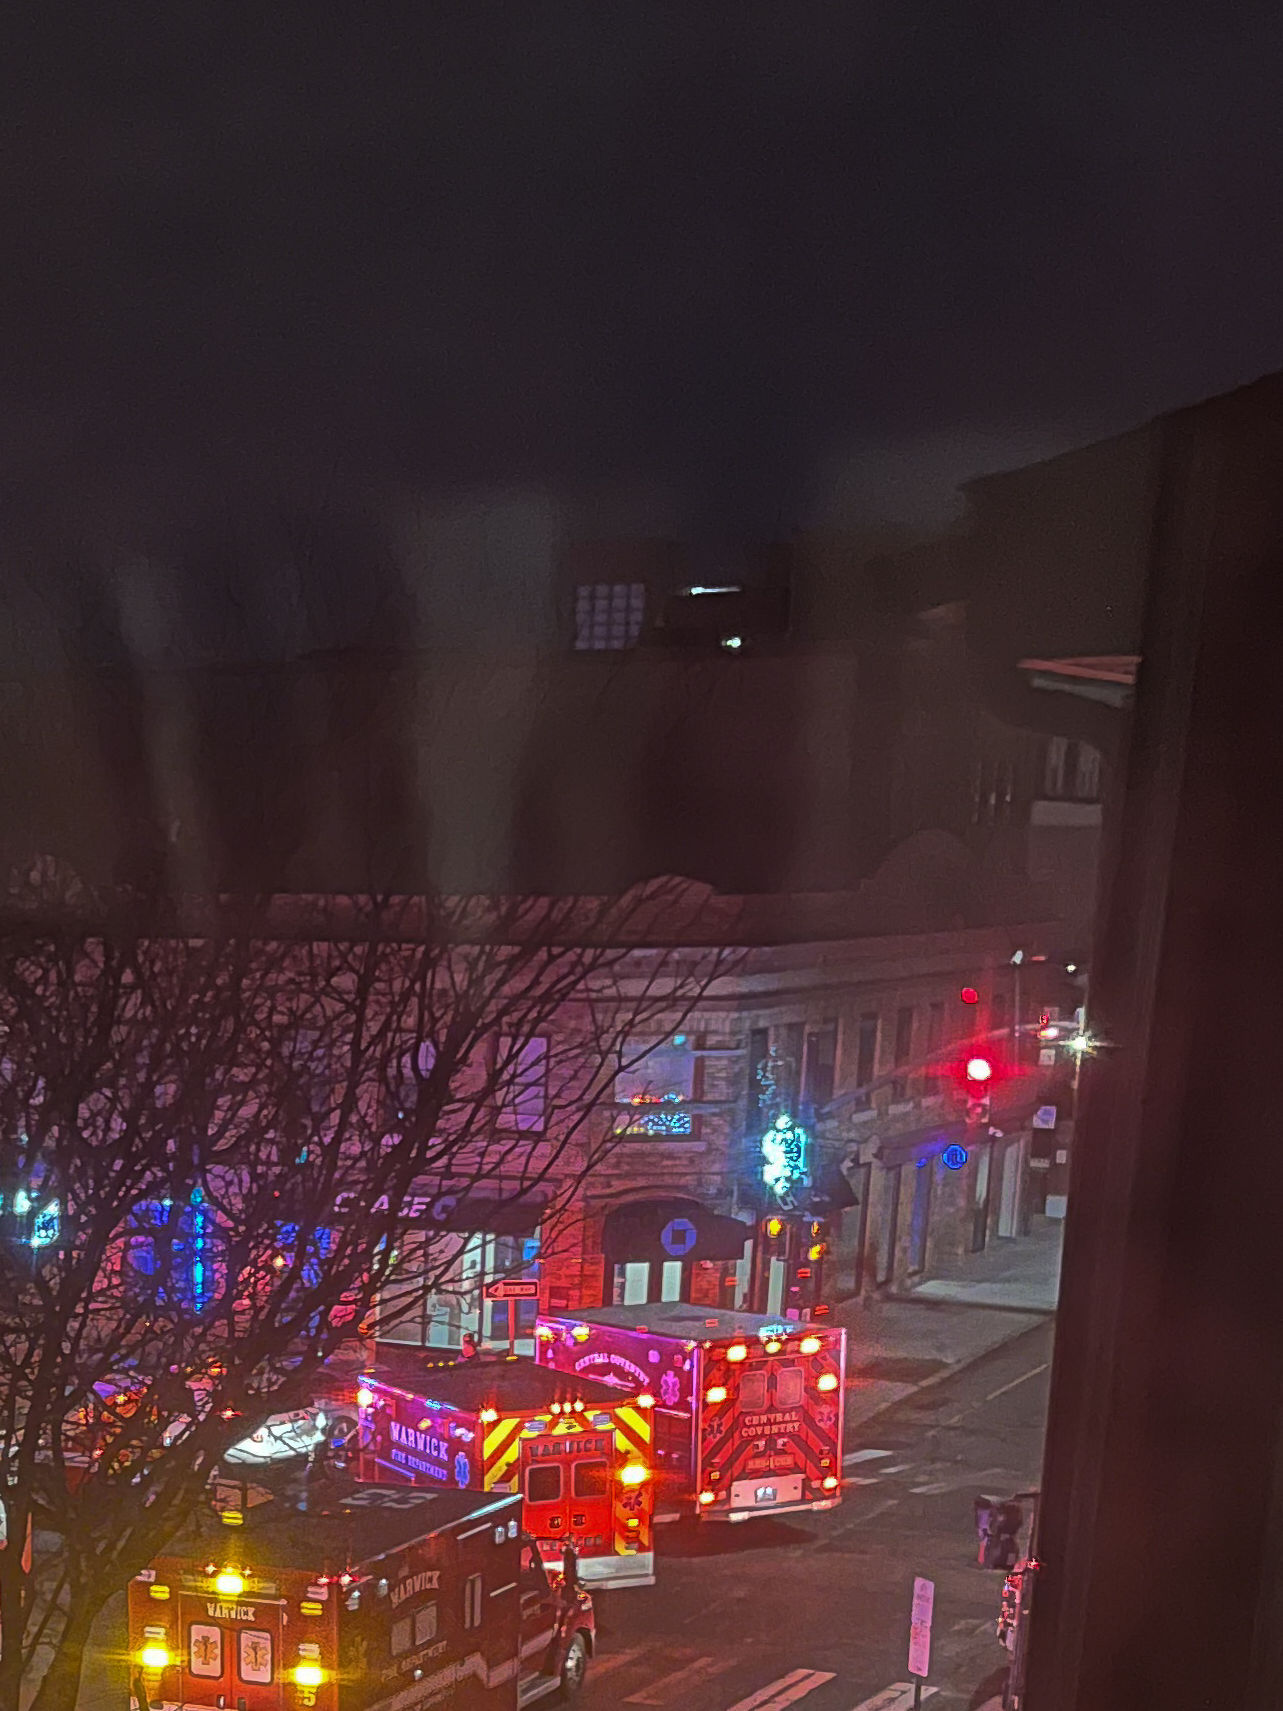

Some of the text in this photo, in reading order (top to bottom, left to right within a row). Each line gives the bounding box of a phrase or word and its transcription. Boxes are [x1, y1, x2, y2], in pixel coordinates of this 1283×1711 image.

[745, 1411, 798, 1425] CENTRAL
[742, 1422, 801, 1437] COVENTRY
[390, 1421, 449, 1462] WARWICK
[390, 1571, 440, 1609] WARWICK
[207, 1602, 256, 1622] WARWICK
